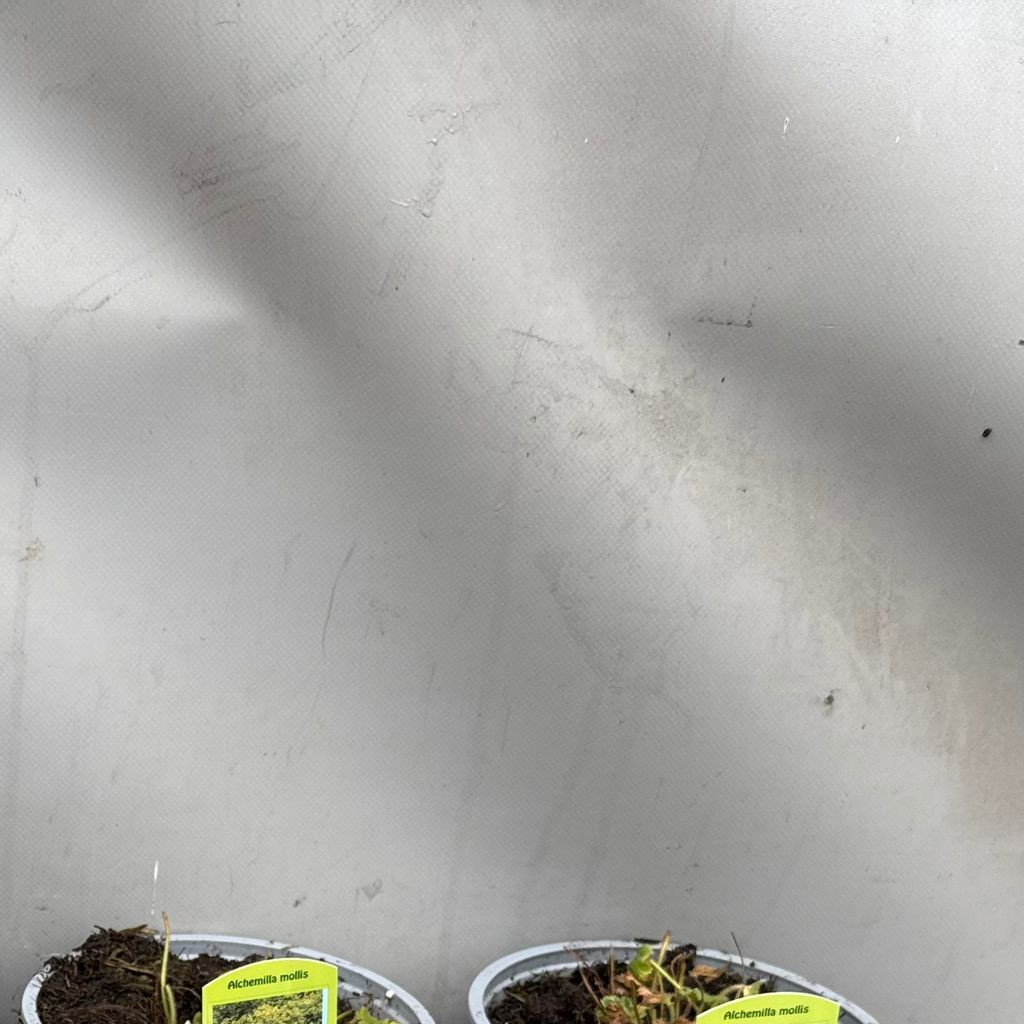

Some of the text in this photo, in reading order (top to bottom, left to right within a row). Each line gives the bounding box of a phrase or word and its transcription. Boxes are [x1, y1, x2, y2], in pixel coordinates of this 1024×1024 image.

[227, 969, 309, 990] Alchemilla mollis
[723, 1004, 810, 1020] Alchemilla mollis
